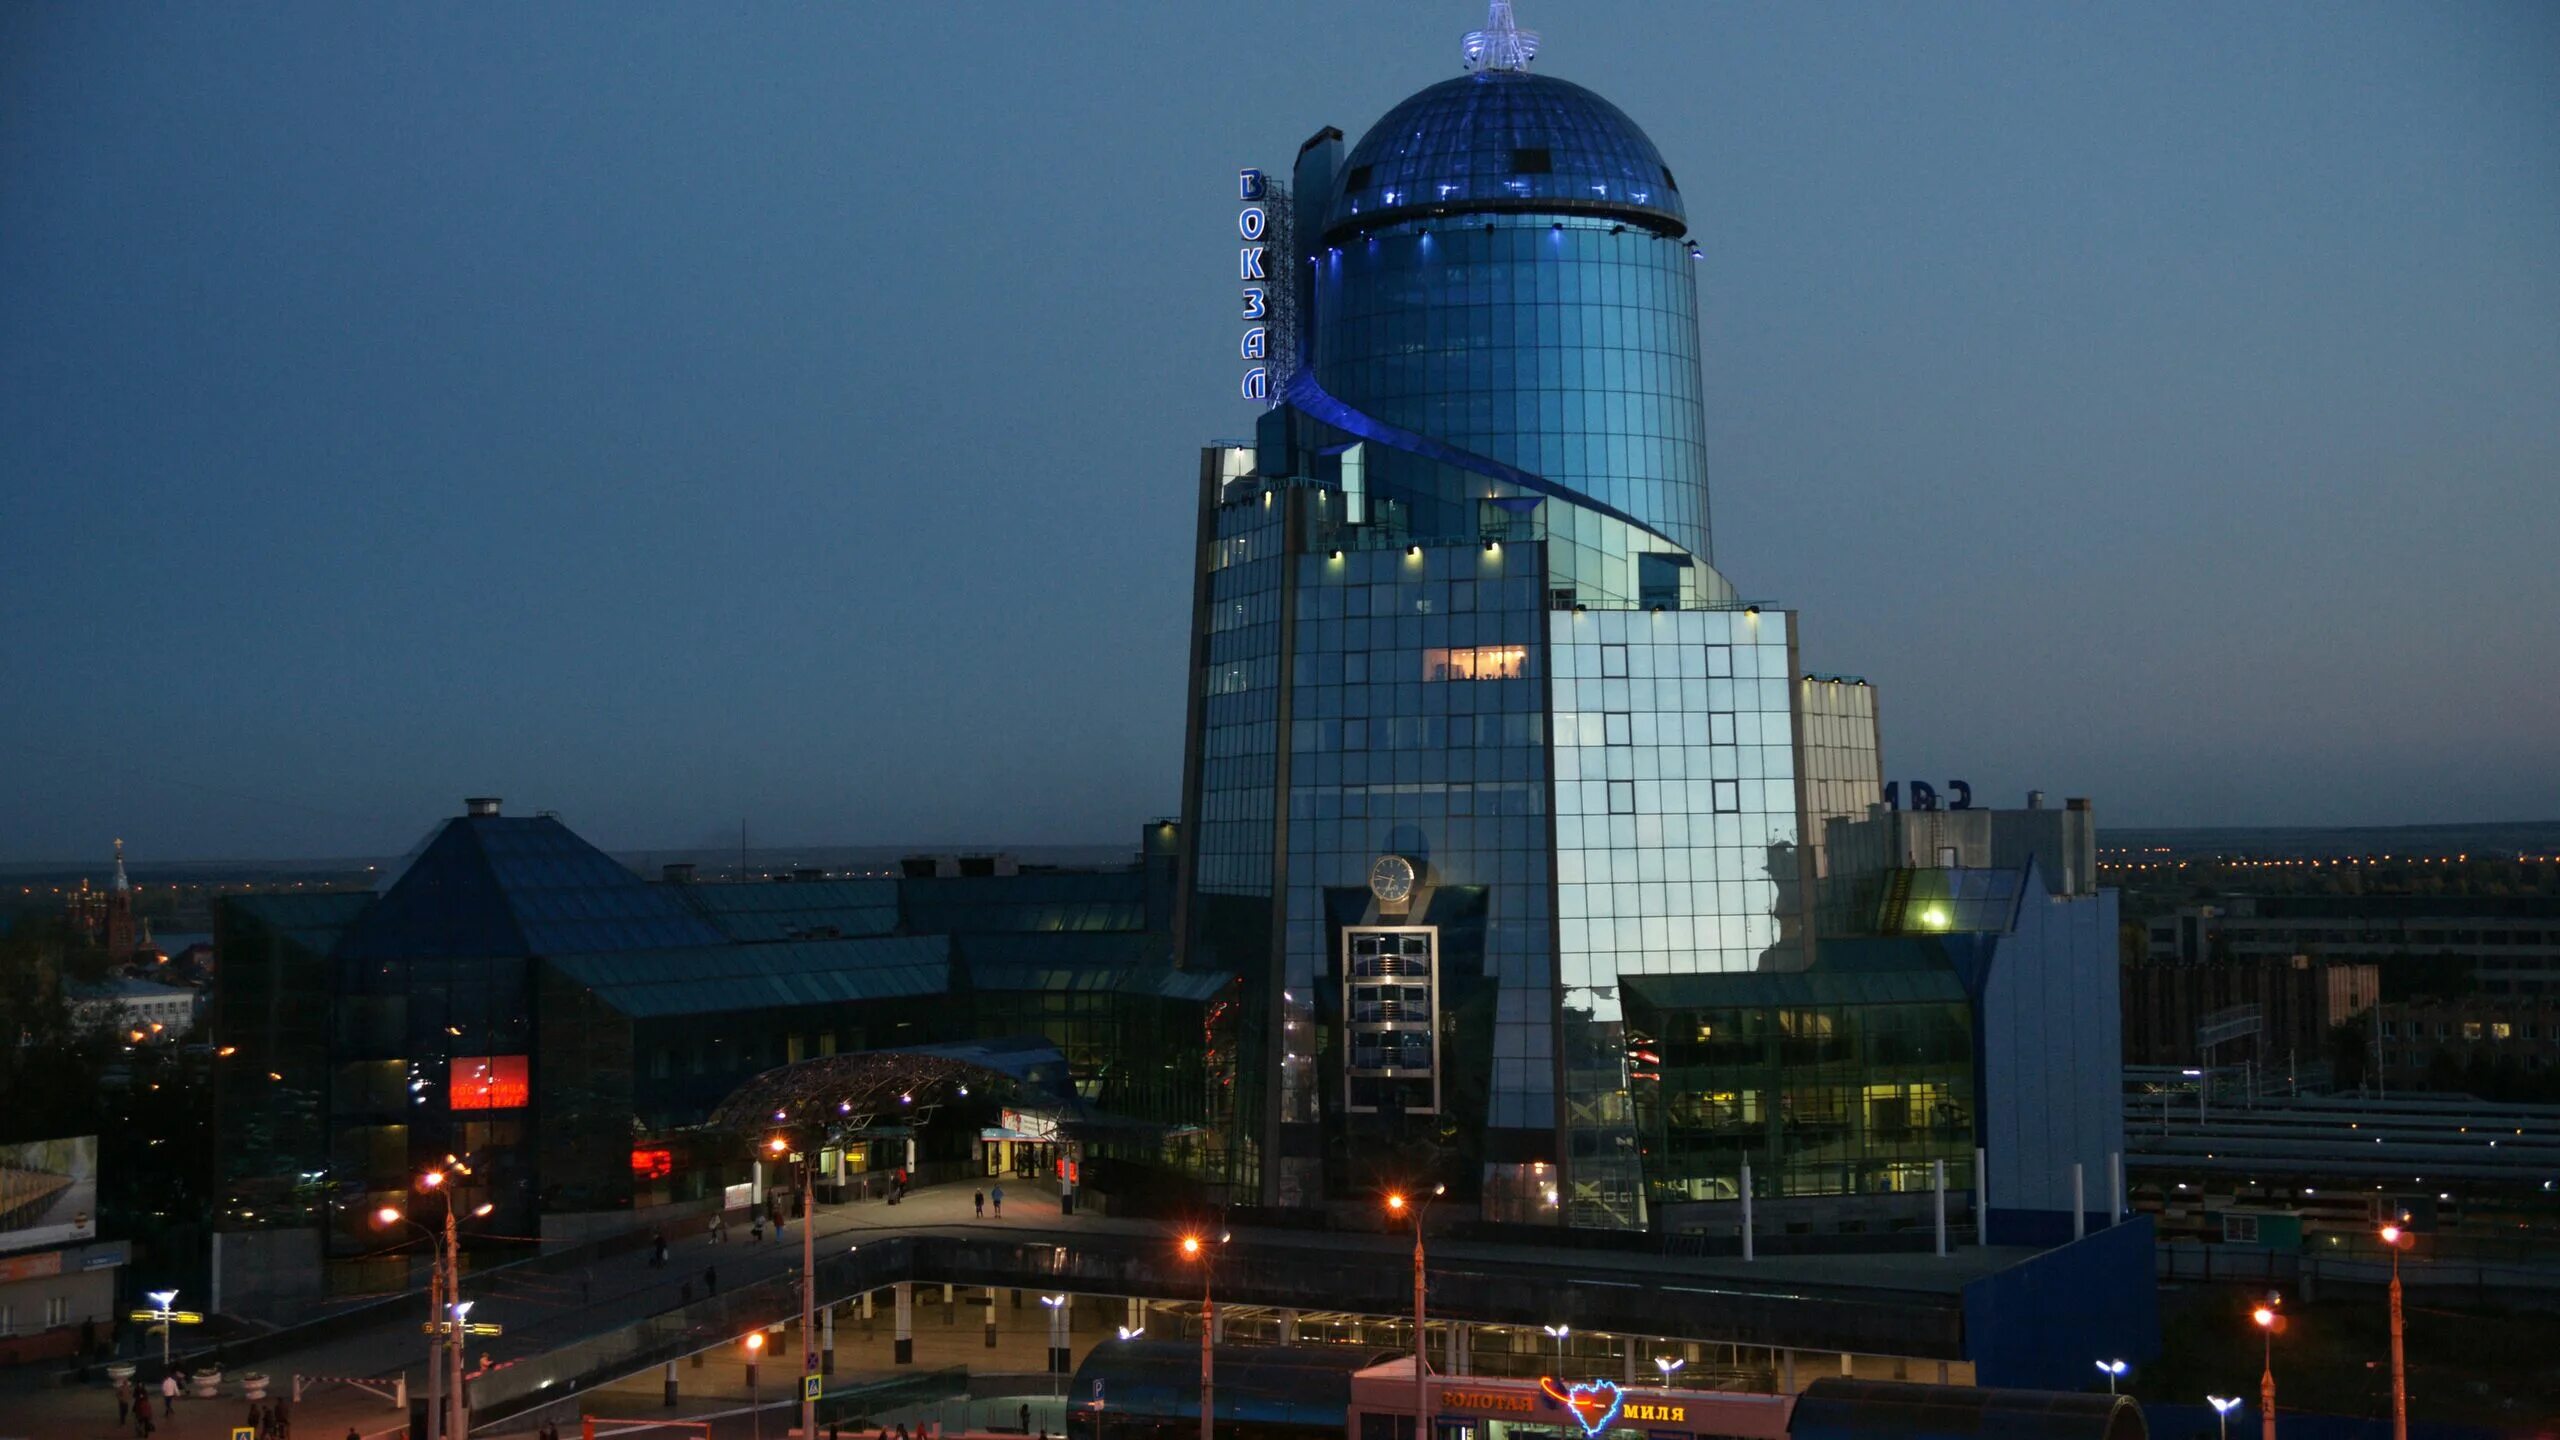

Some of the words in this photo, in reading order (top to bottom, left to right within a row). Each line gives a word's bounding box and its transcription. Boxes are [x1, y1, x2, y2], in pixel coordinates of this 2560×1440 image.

[1239, 168, 1267, 399] ВОКЗАЛ
[1441, 1392, 1535, 1412] ЗОЛОТАЯ
[1623, 1403, 1686, 1422] МИЛЯ
